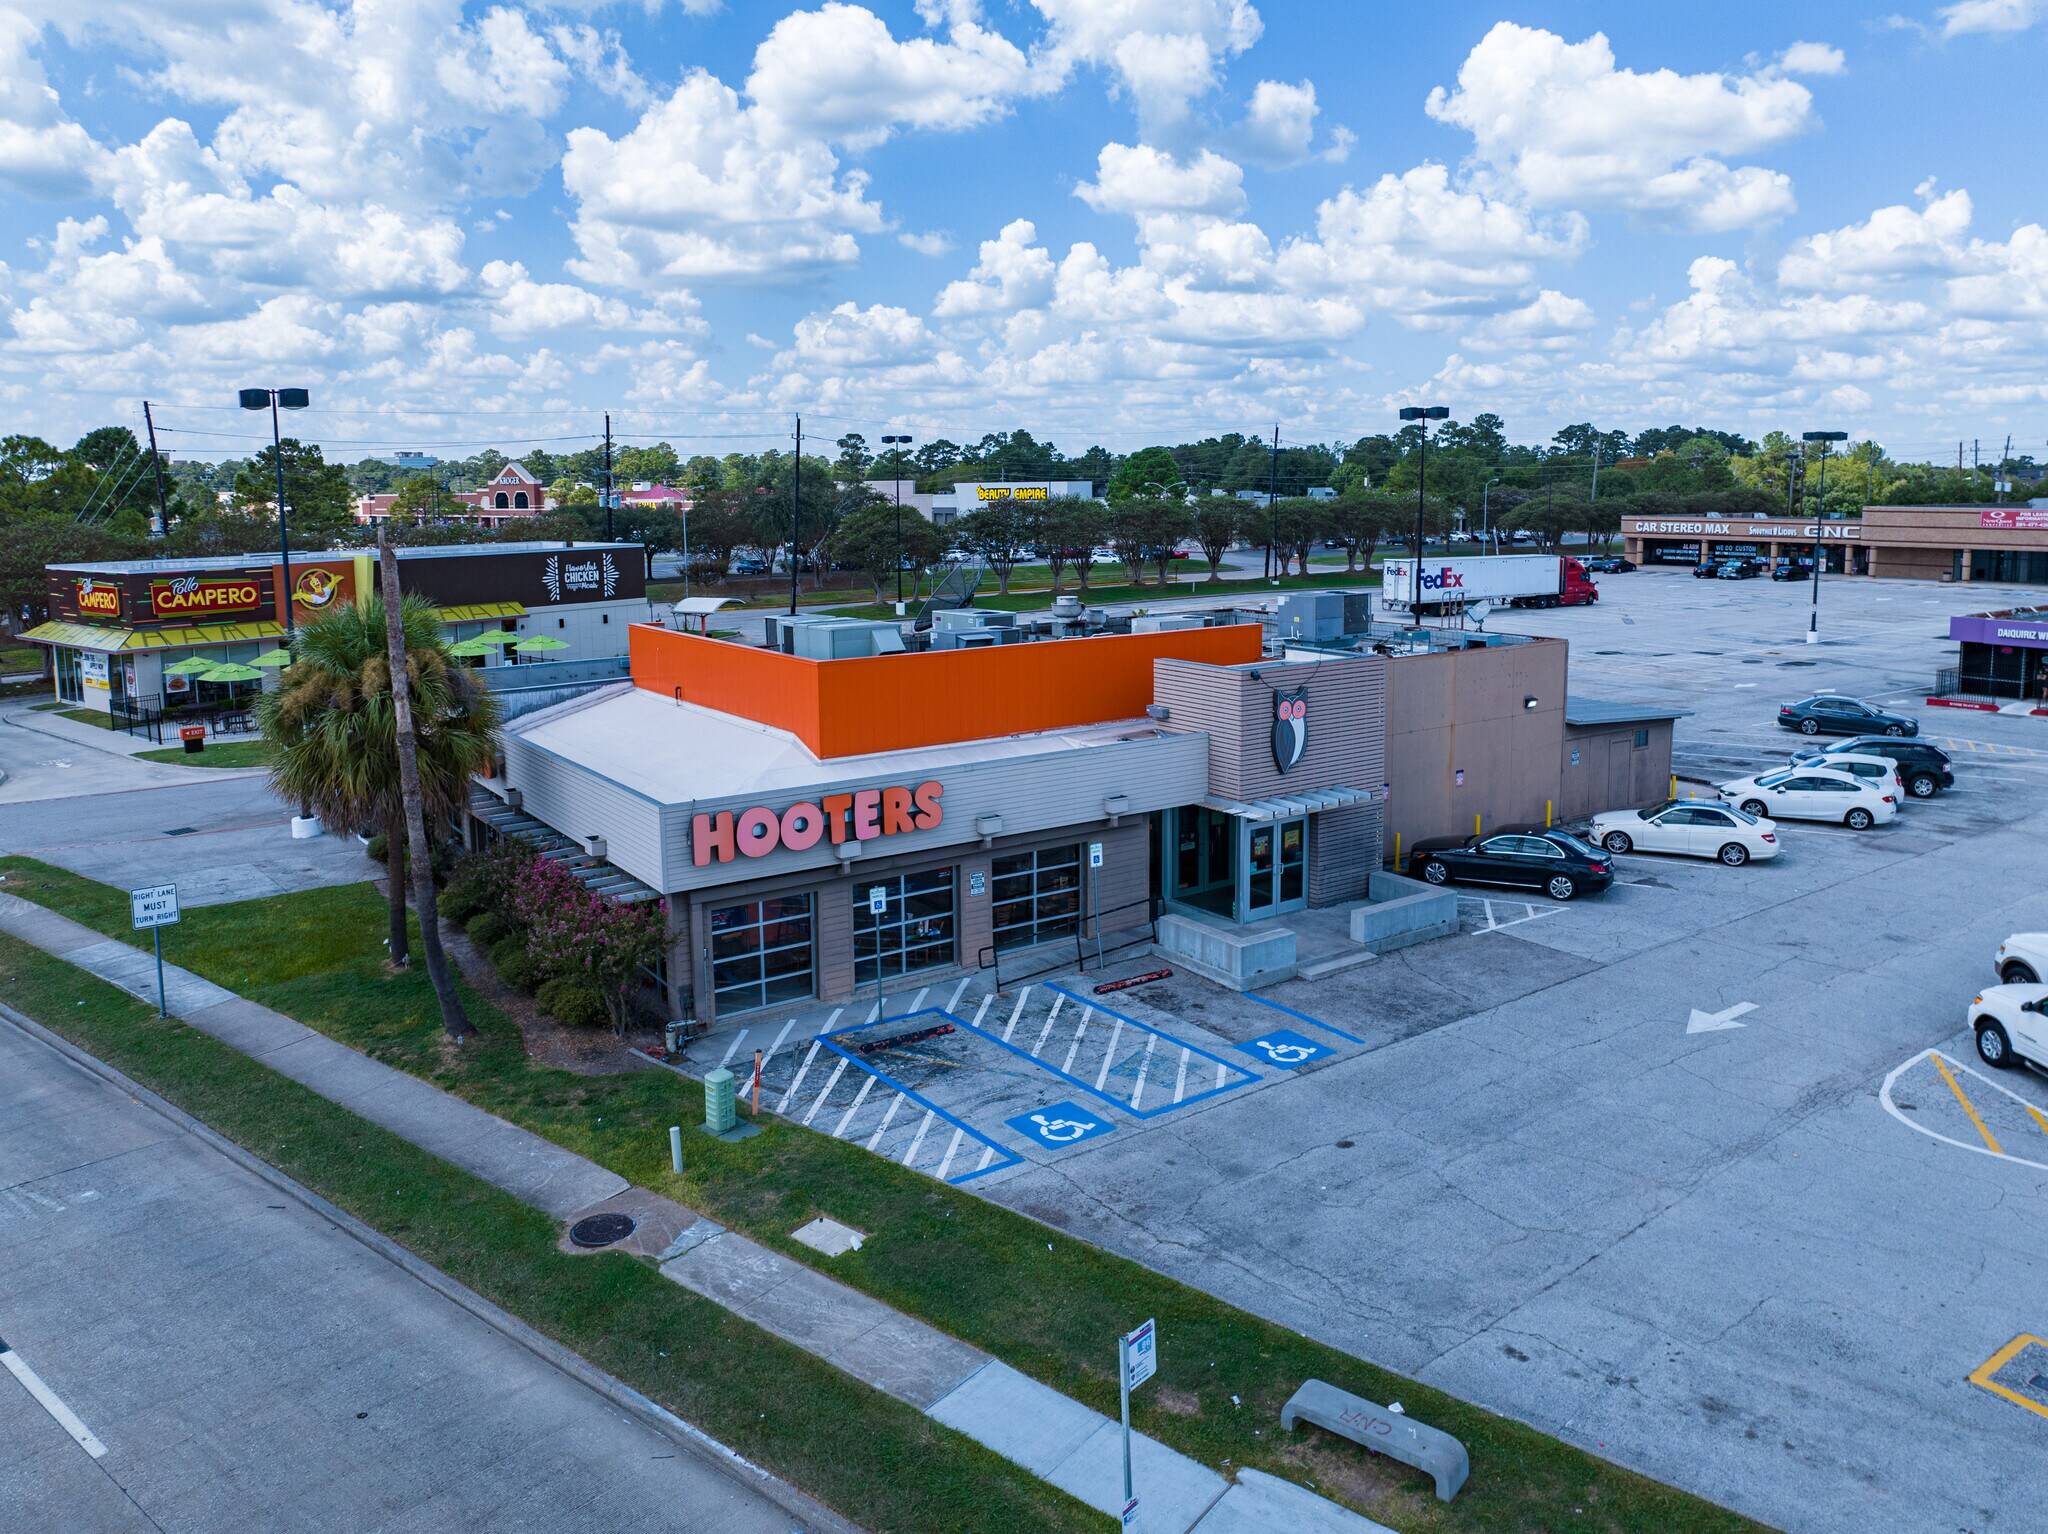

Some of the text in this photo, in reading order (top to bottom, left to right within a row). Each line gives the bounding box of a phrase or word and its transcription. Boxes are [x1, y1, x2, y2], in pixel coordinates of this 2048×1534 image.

[978, 487, 1047, 501] BEAUTY EMPIRE
[1636, 522, 1730, 534] CAR STEREO MAX
[1804, 525, 1861, 538] GNC
[564, 570, 600, 583] CHICKEN
[1386, 566, 1408, 577] FedEx
[168, 576, 199, 595] Pollo
[79, 589, 117, 610] CAMPERO
[156, 586, 257, 608] CAMPERO
[1997, 628, 2037, 640] DAIQUIRIZ
[692, 780, 944, 867] HOOTERS
[133, 888, 175, 900] RIGHT LANE
[143, 900, 167, 912] MUST
[135, 910, 177, 924] TURN RIGHT
